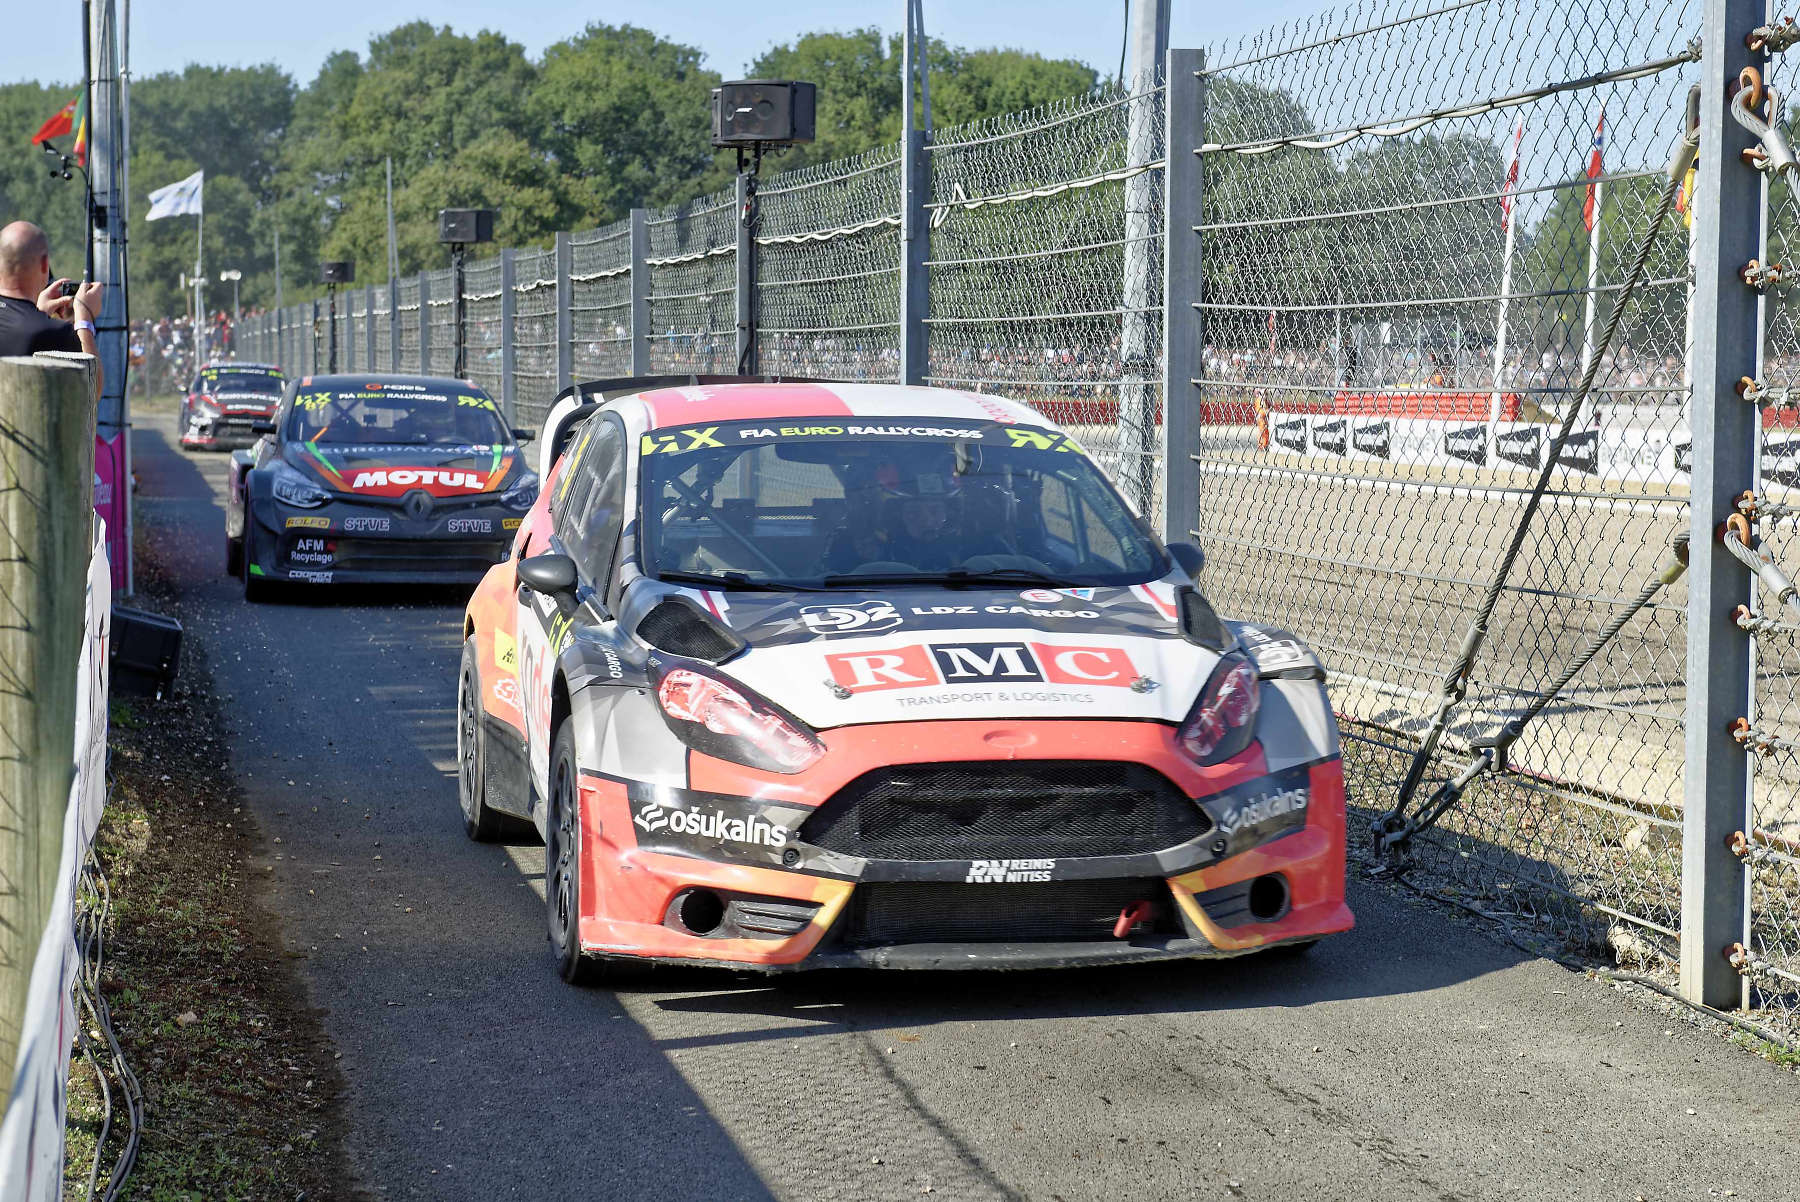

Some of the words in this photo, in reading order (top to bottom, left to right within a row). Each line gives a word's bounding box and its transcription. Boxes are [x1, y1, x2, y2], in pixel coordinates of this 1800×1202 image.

[386, 393, 448, 402] RALLYCROSS
[739, 428, 778, 439] FIA
[779, 426, 844, 436] EURO
[847, 426, 984, 439] RALLYCROSS
[352, 470, 485, 489] MOTUL
[344, 518, 390, 531] STVE
[448, 519, 492, 532] STVE
[297, 539, 324, 551] AFM
[291, 551, 333, 564] Recyclage
[911, 606, 979, 615] LDZ
[984, 605, 1100, 619] CARGO
[838, 646, 1120, 687] RMC
[896, 692, 993, 707] TRANSPORT
[999, 692, 1010, 701] &
[1013, 692, 1095, 703] LOGISTICS
[669, 806, 788, 848] ošukalns
[1010, 858, 1056, 870] REINIS
[1005, 870, 1052, 883] NITISS
